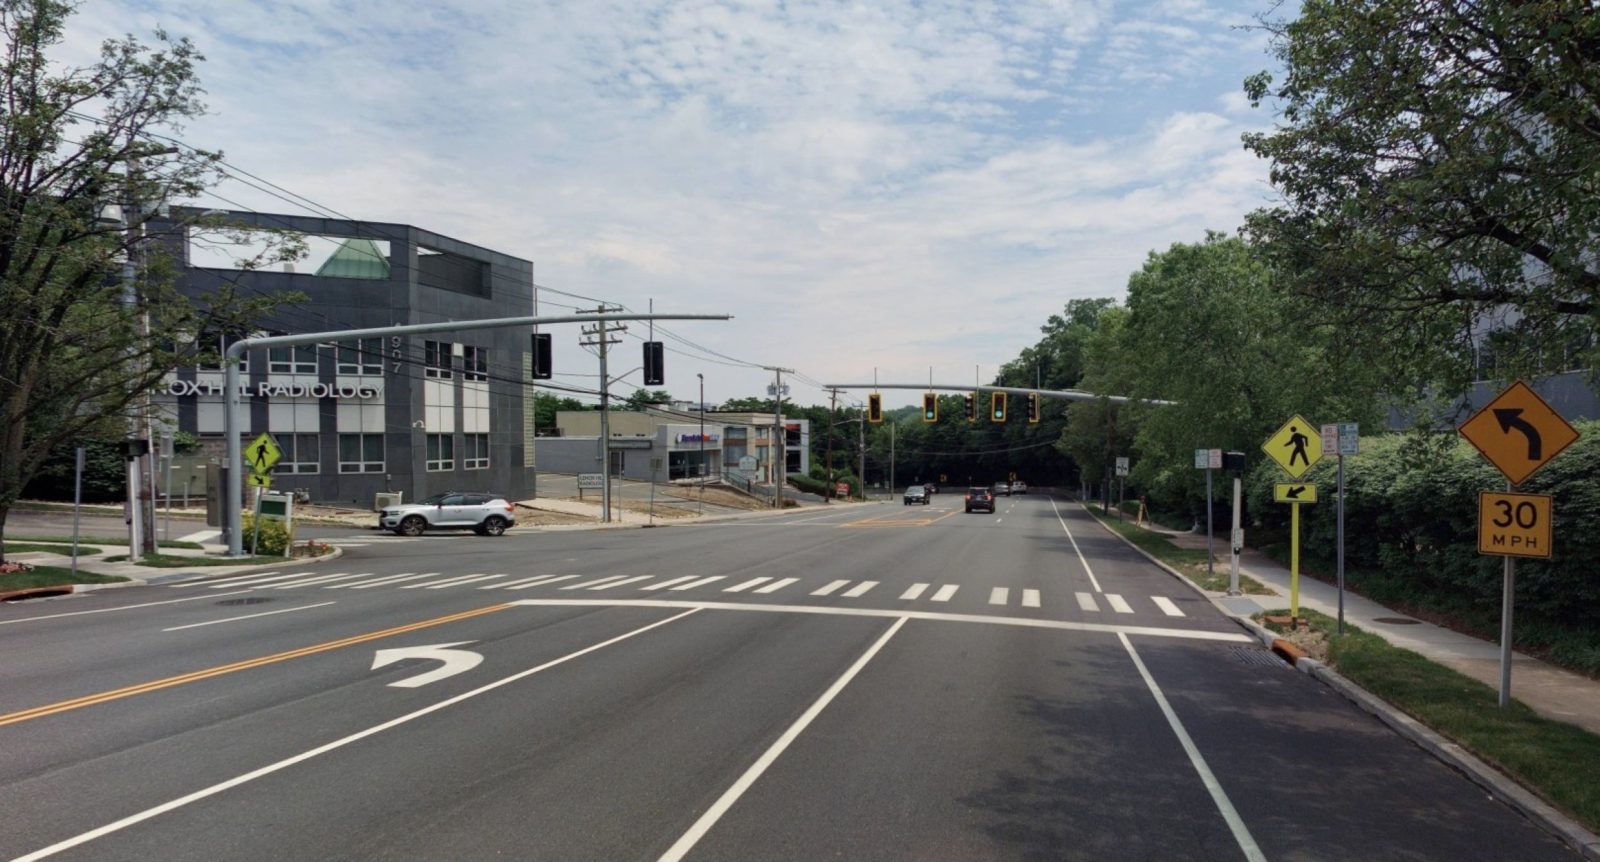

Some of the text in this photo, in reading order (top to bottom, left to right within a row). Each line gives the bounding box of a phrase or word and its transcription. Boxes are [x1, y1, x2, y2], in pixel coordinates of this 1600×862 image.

[208, 381, 254, 397] HL
[258, 381, 385, 399] RADIOLOGY
[1492, 499, 1537, 529] 30
[1492, 534, 1537, 548] MPH
